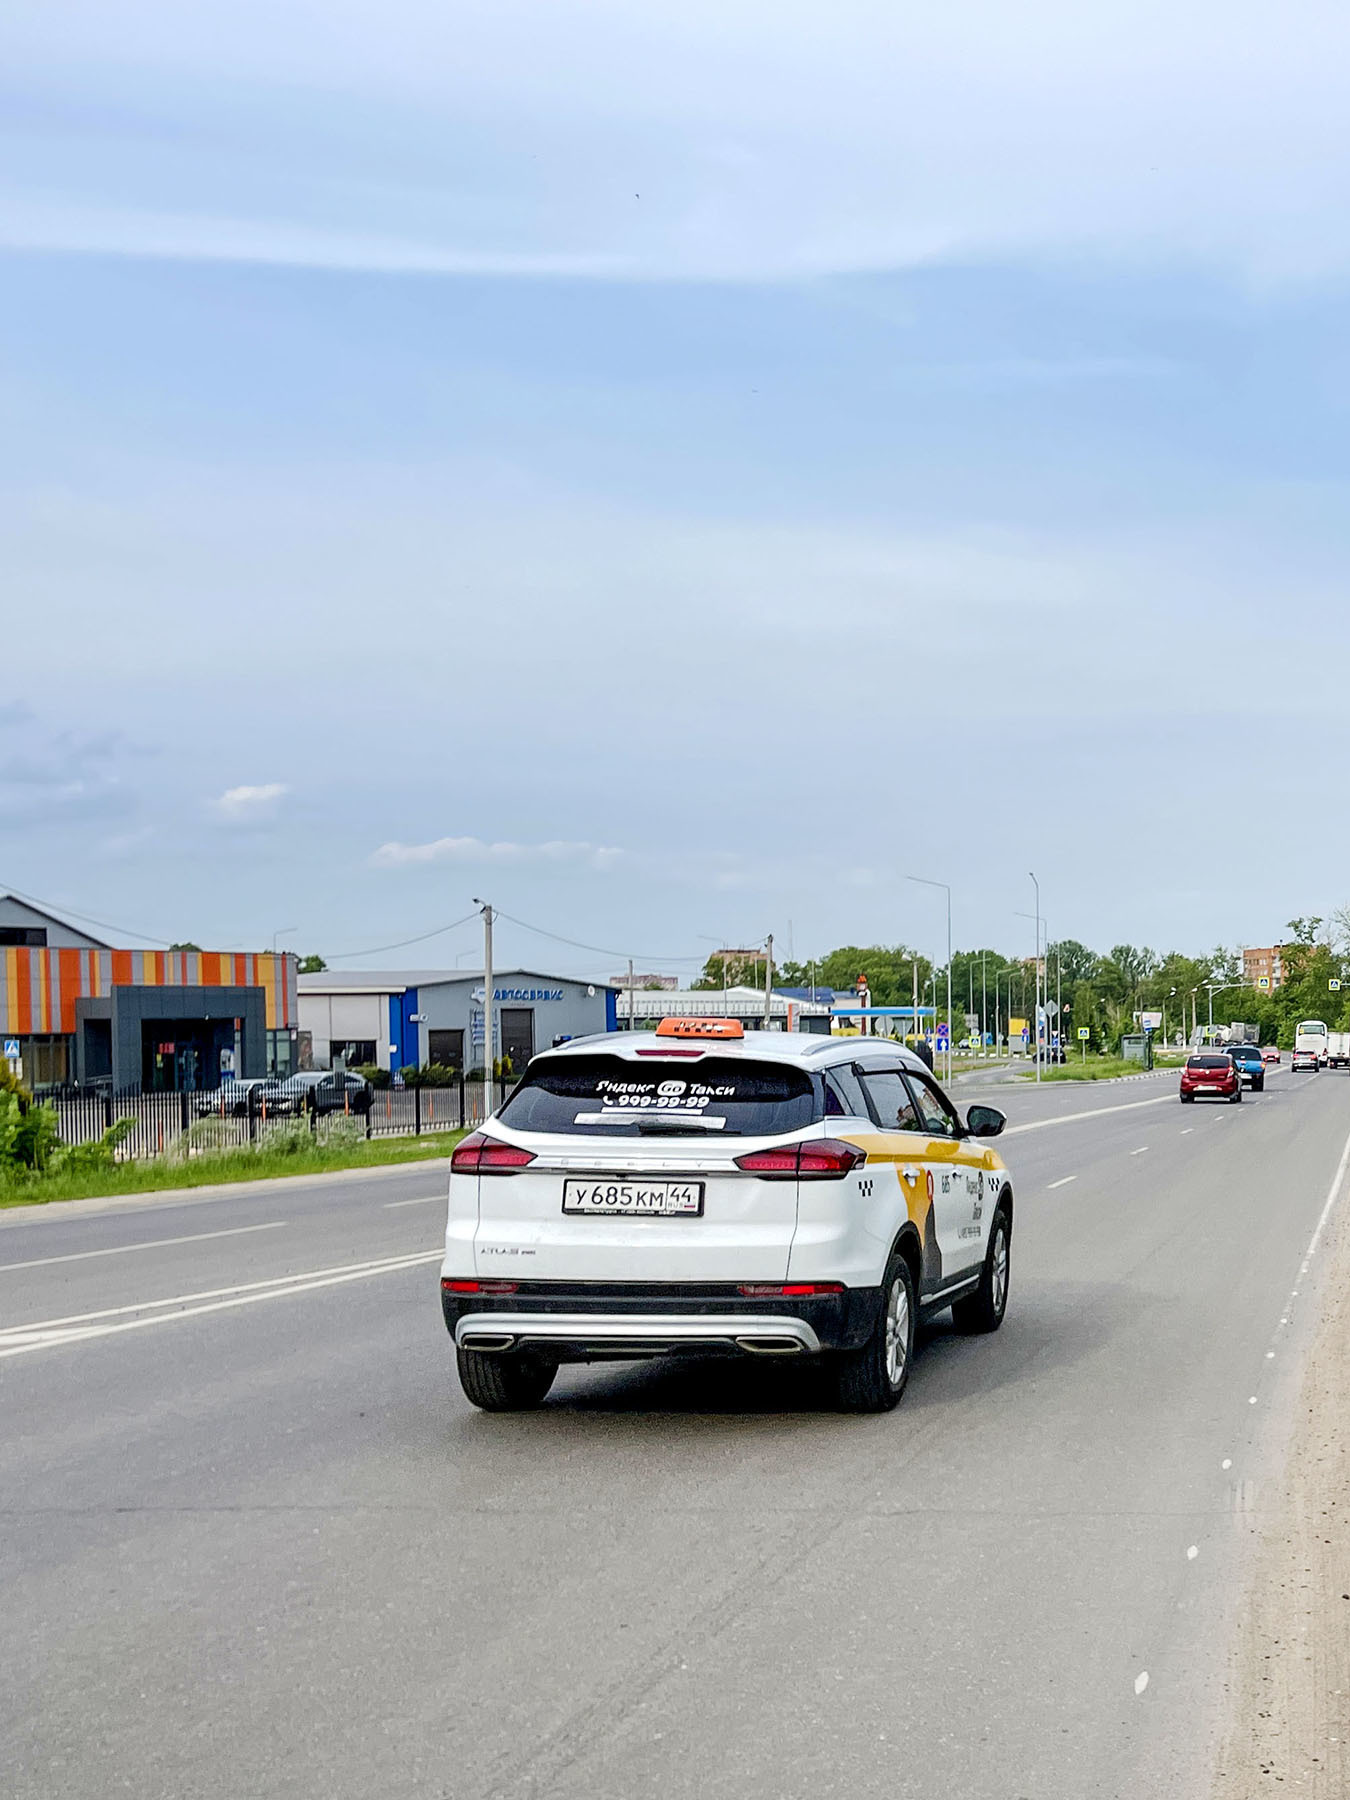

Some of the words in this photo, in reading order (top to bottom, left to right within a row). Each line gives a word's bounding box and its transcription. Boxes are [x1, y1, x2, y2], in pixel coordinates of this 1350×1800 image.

[493, 988, 564, 1001] АВТОСЕРВИС
[690, 1083, 736, 1096] Такси
[618, 1095, 710, 1108] 999-99-99
[669, 1186, 692, 1203] 44
